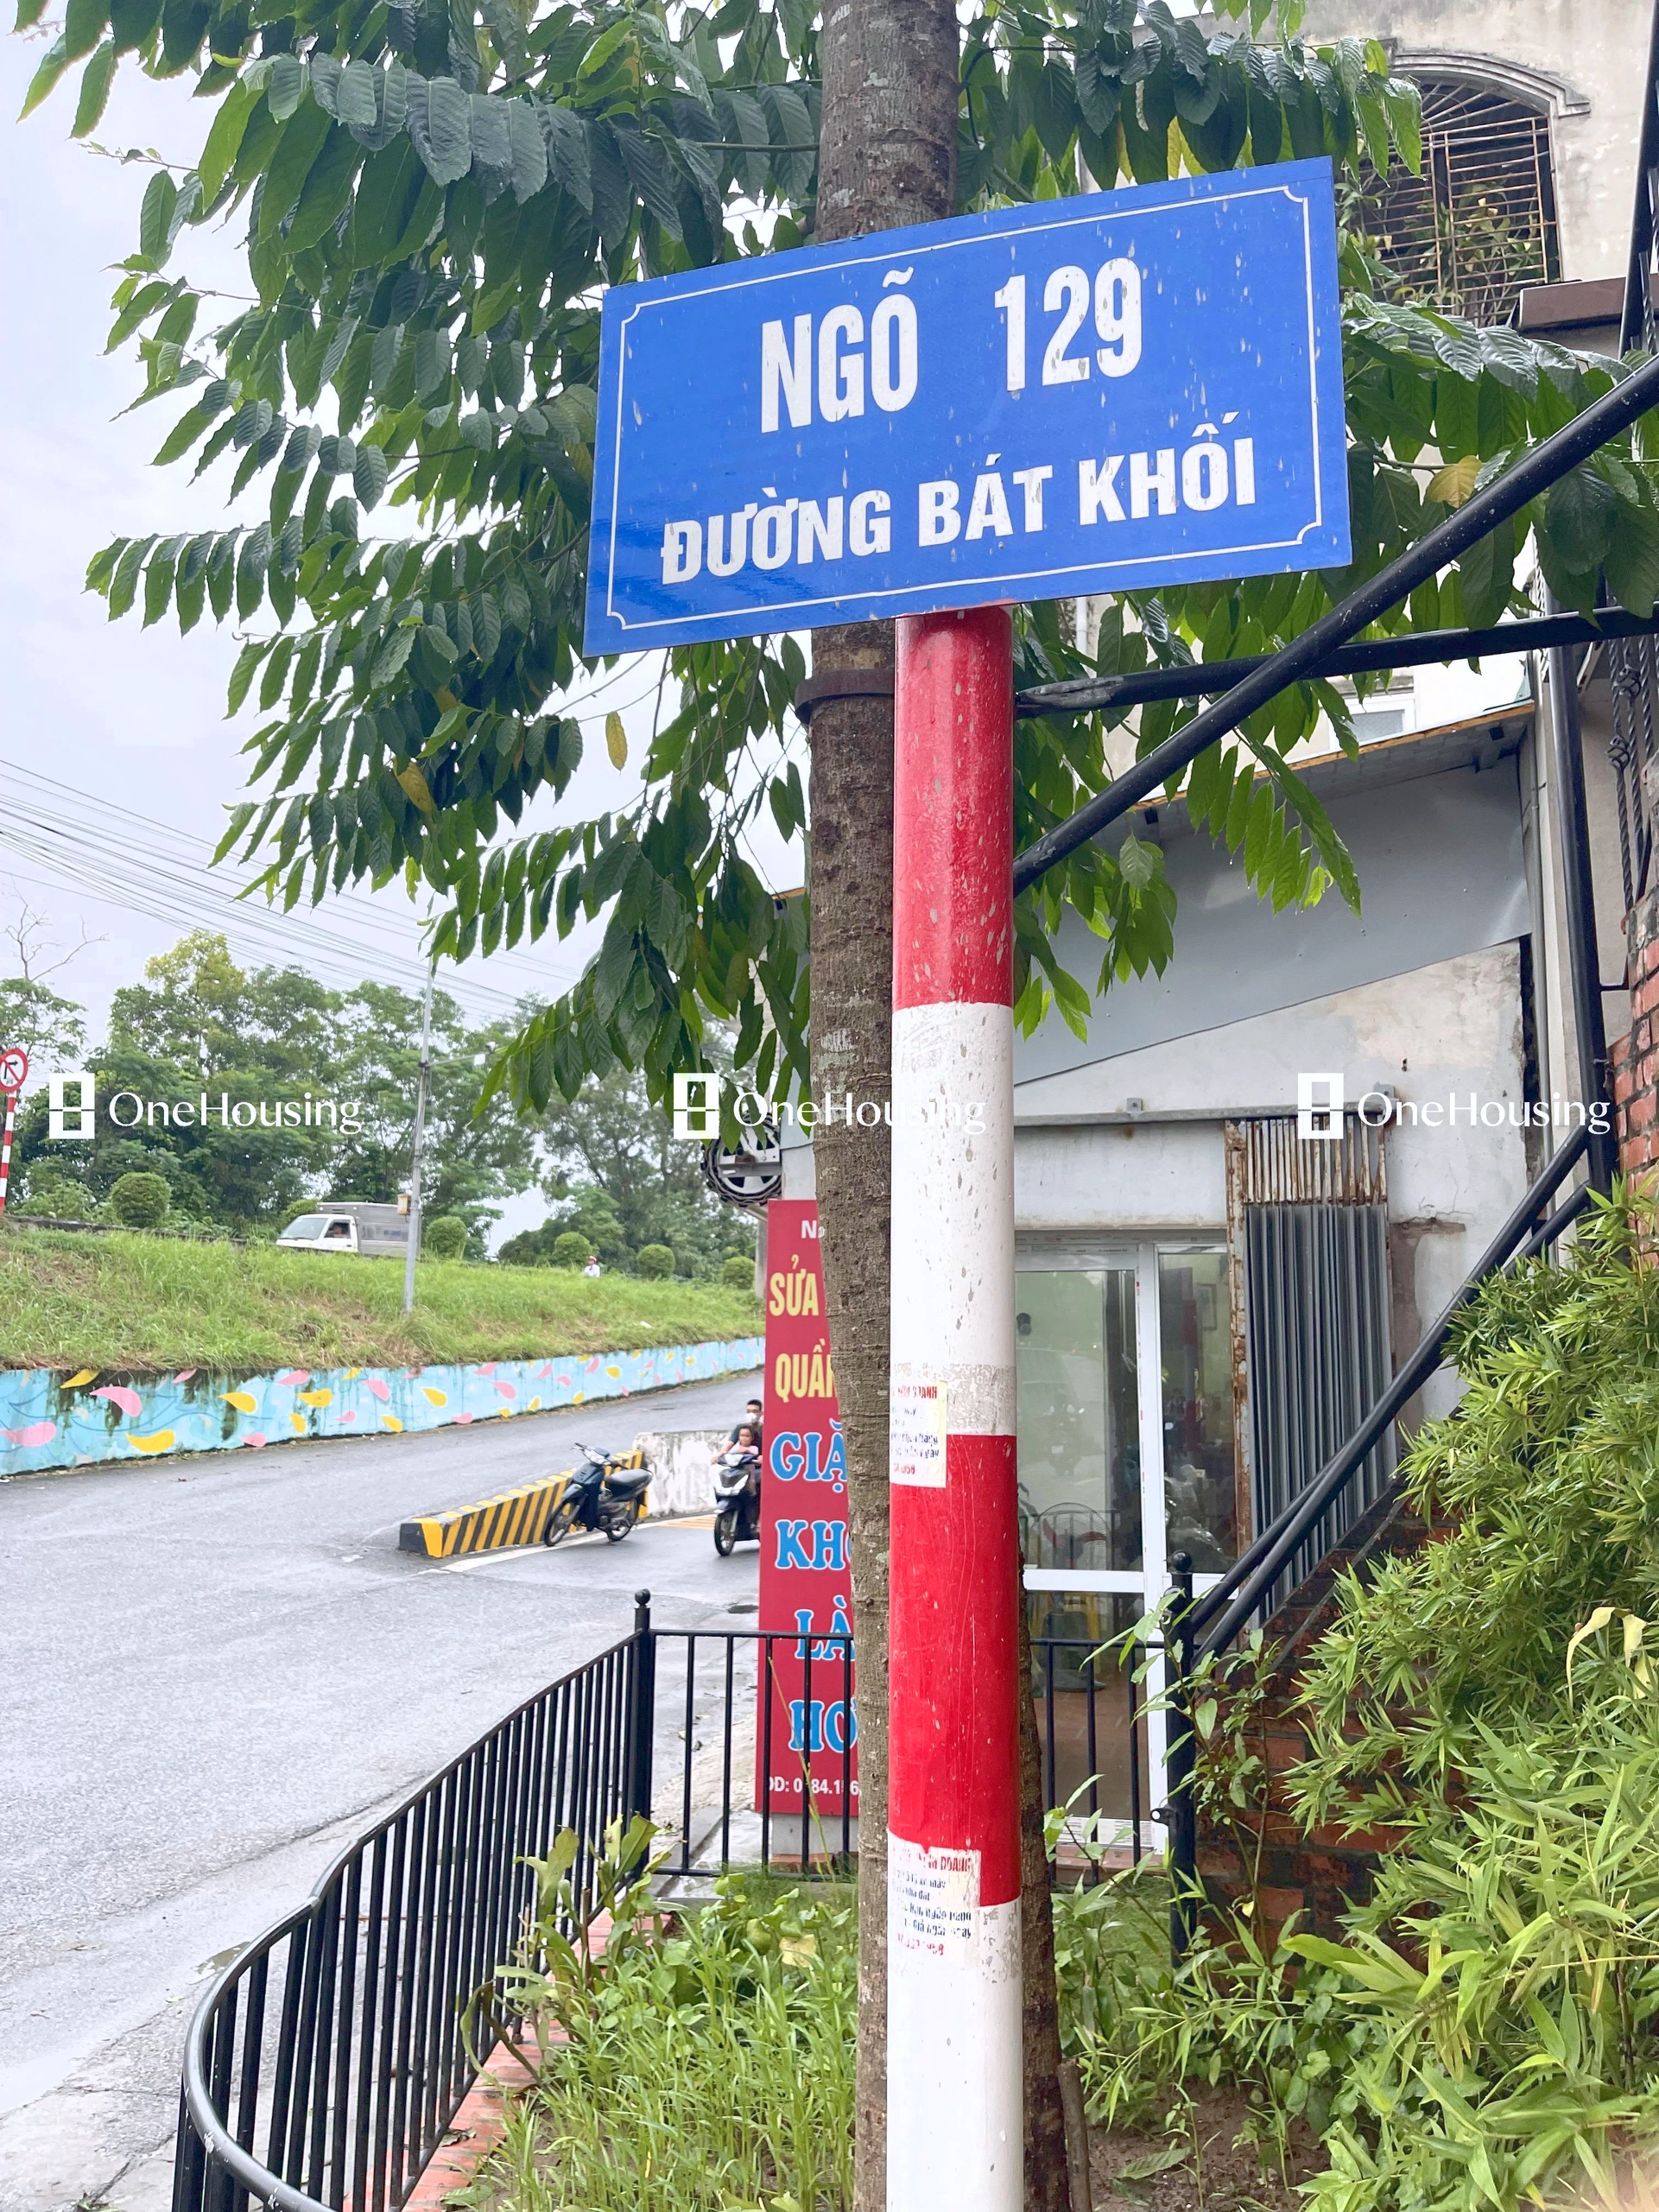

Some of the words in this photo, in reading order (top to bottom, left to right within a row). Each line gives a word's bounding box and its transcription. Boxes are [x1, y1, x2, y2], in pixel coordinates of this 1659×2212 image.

[760, 266, 918, 434] NGÕ
[993, 257, 1142, 392] 129
[661, 486, 891, 586] ĐƯỜNG
[918, 453, 1053, 548] BÁT
[1079, 410, 1256, 525] KHỐI
[769, 1254, 820, 1316] SỬA
[775, 1519, 852, 1569] KH
